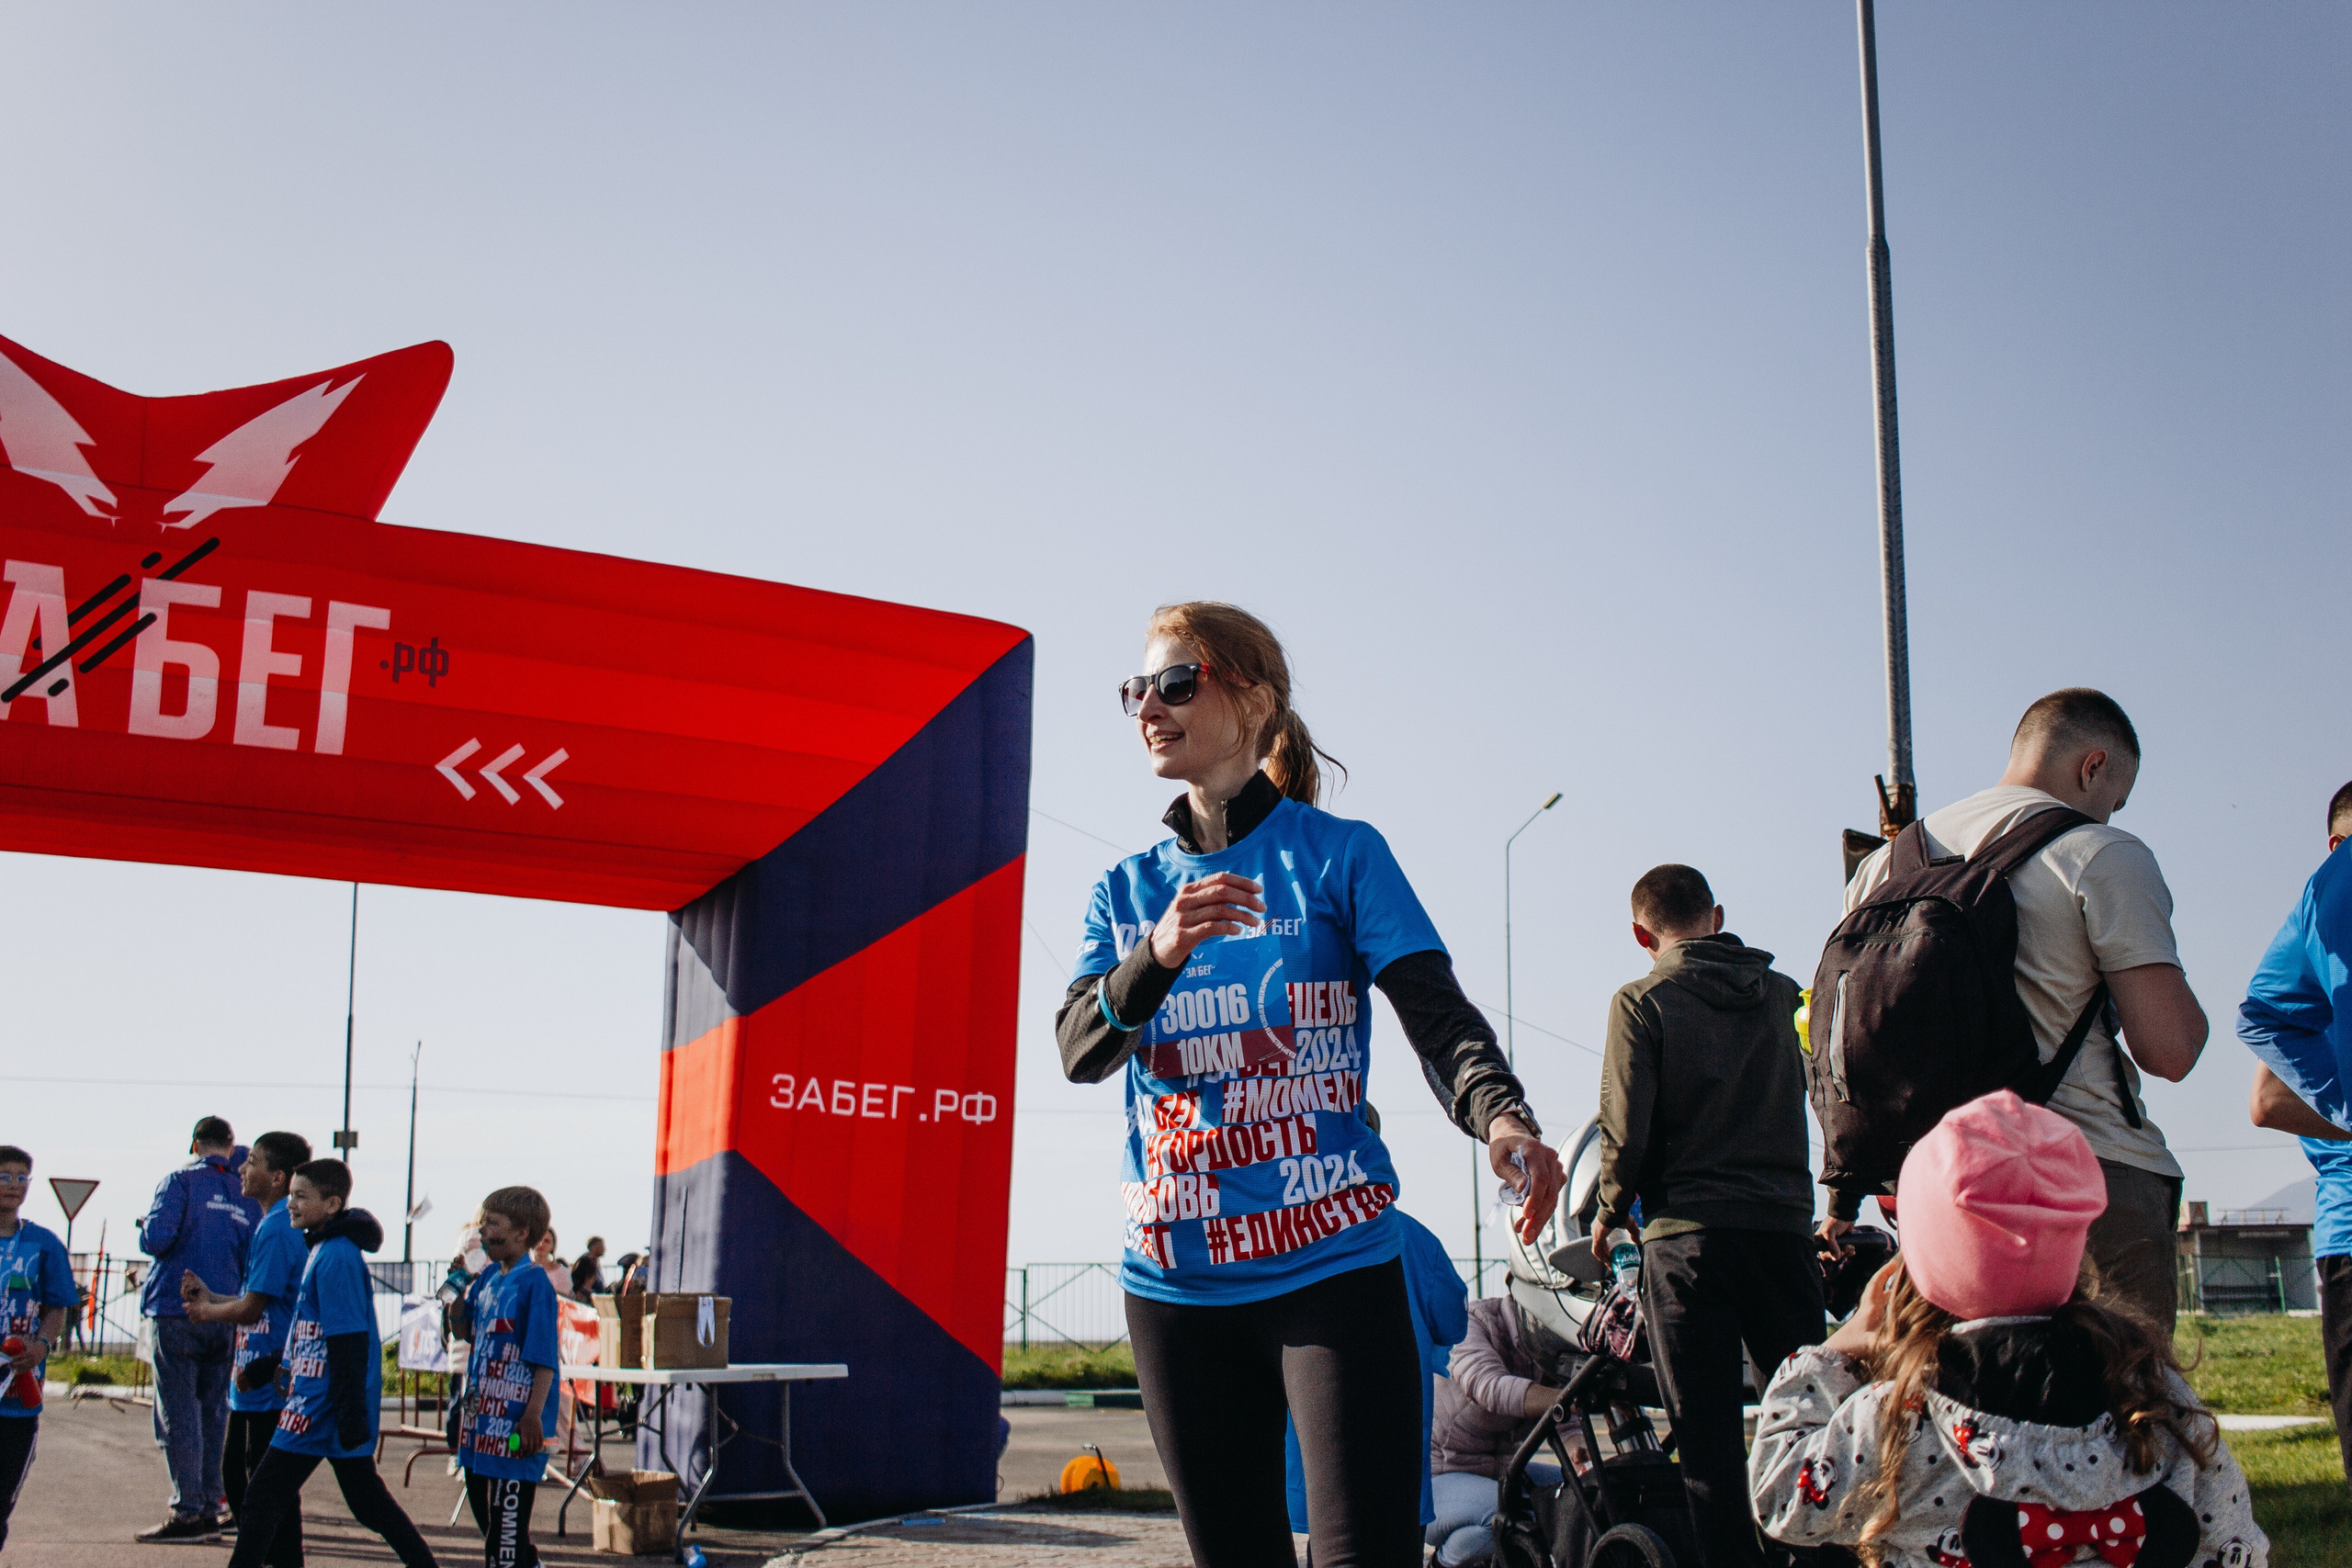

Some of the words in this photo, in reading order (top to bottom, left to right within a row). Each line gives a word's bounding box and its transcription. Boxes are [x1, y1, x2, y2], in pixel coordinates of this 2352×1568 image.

[128, 577, 391, 756] БЕГ
[1272, 917, 1302, 936] БЕГ
[1159, 983, 1251, 1035] 30016
[1295, 1026, 1362, 1076] 2024
[770, 1072, 998, 1126] ЗАБЕГ.РФ
[1222, 1069, 1362, 1124] #МОМЕНТ
[1147, 1112, 1317, 1181] #ГОРДОСТЬ
[1279, 1149, 1369, 1206] 2024
